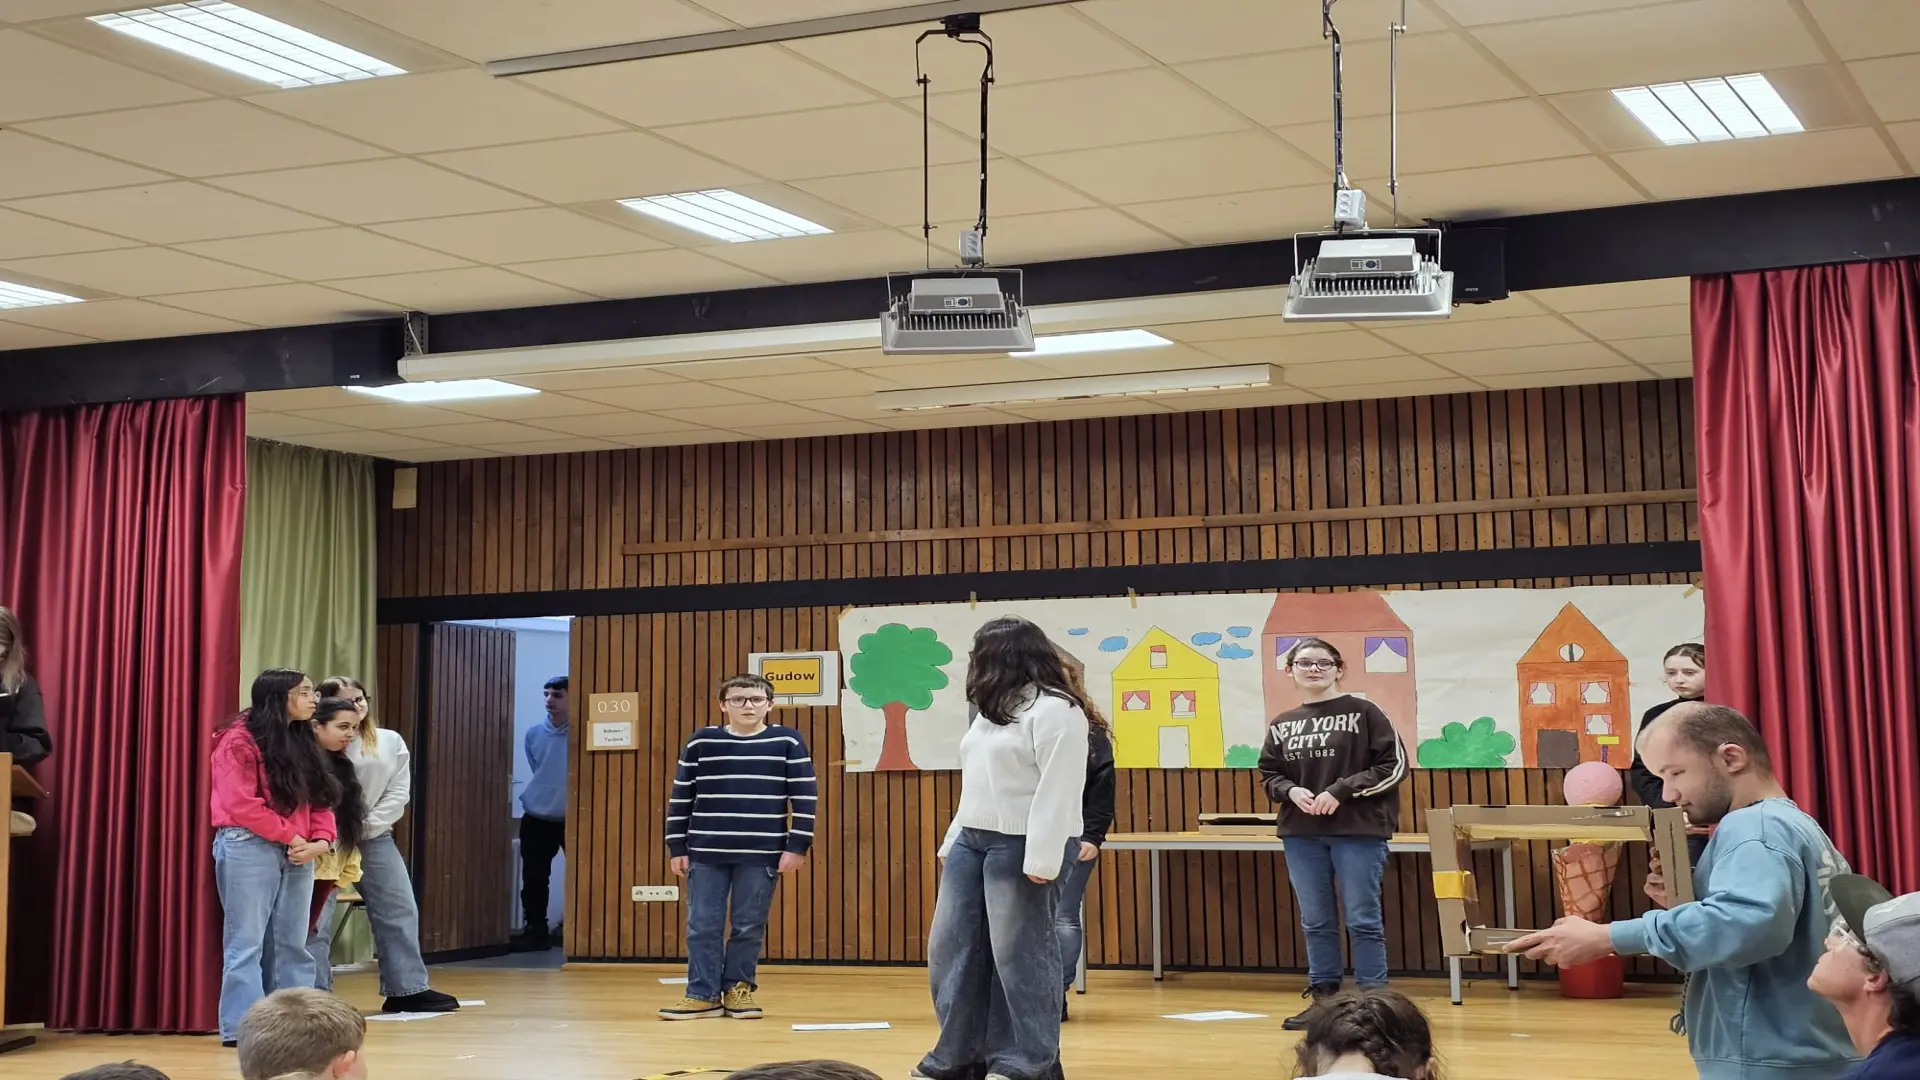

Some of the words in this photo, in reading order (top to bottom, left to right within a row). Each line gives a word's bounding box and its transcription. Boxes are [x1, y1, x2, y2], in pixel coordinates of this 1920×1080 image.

[765, 671, 815, 681] Gudow
[1270, 719, 1308, 745] NEW
[1311, 712, 1361, 734] YORK
[1287, 732, 1331, 750] CITY
[1283, 751, 1304, 762] EST.
[1309, 748, 1336, 758] 1982
